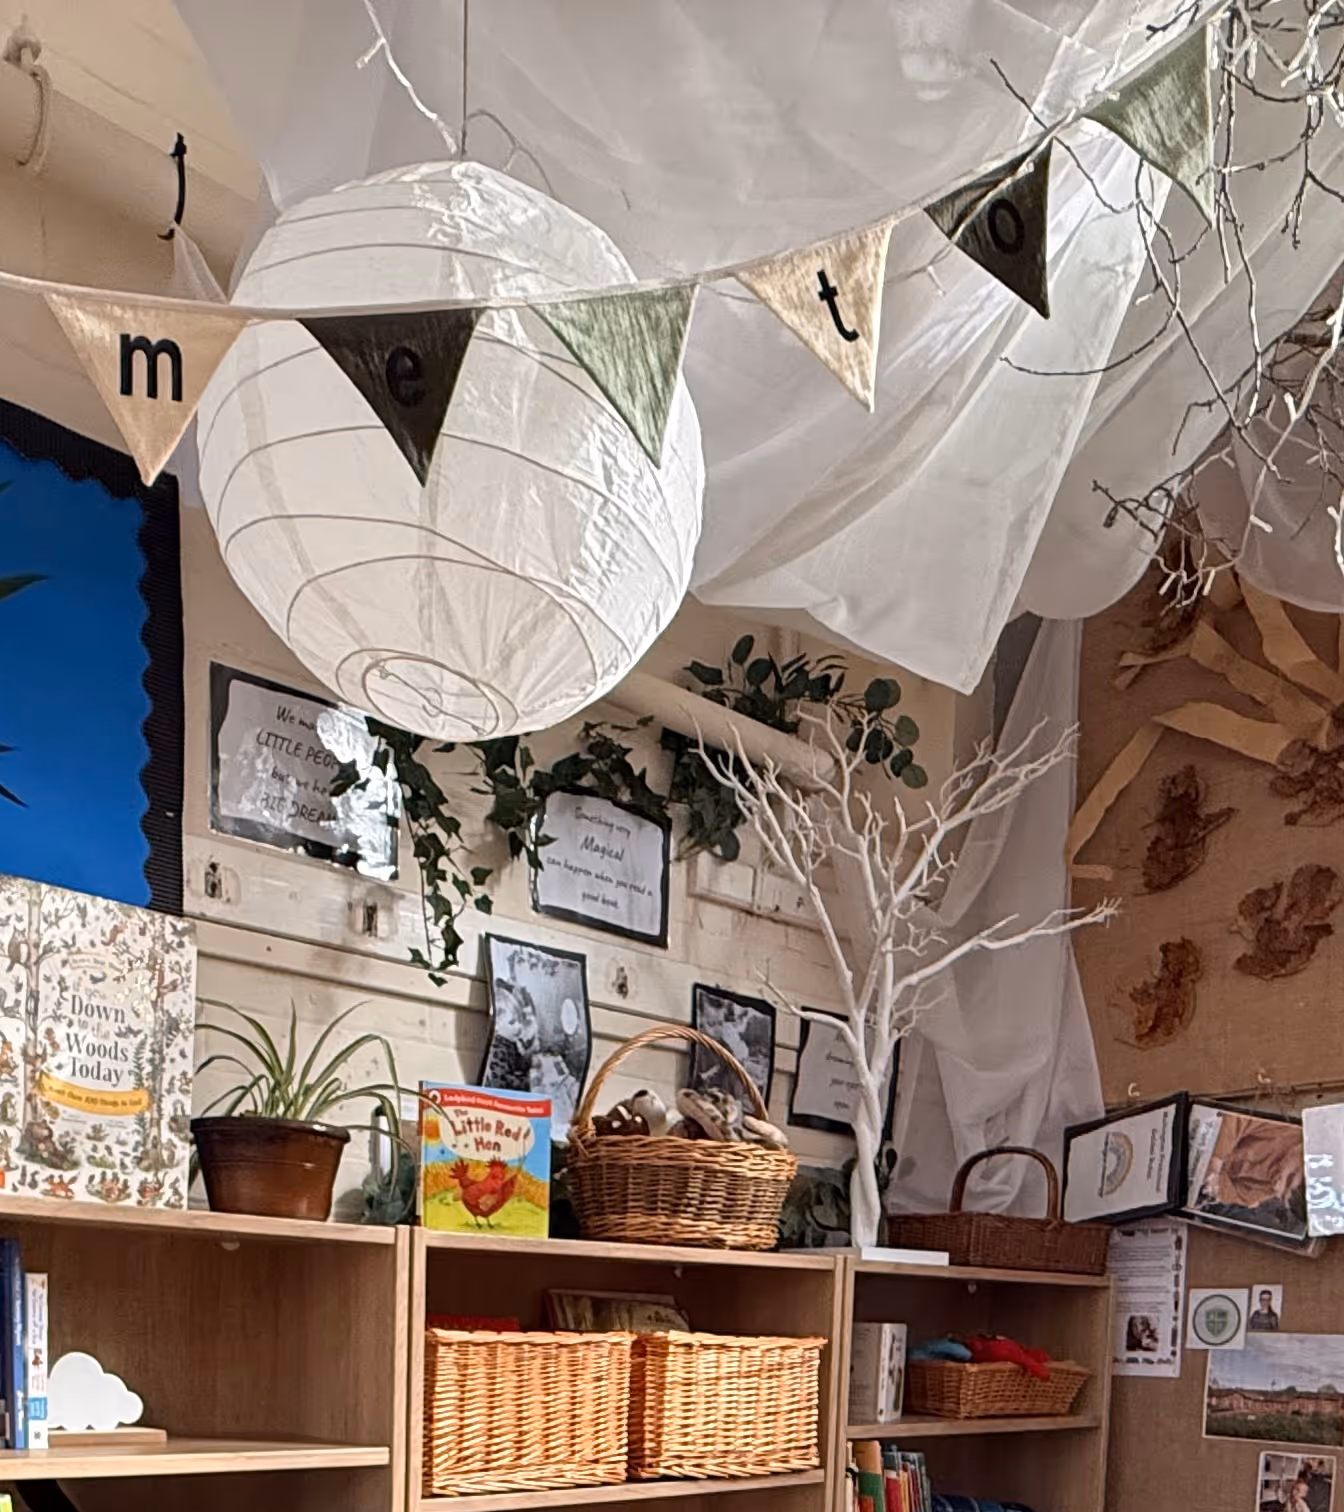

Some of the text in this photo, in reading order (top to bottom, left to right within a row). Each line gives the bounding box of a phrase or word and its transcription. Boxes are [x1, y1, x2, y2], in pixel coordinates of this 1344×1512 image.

[276, 705, 295, 724] We
[257, 730, 303, 760] LITTLE
[580, 835, 625, 862] Magical
[563, 859, 593, 877] happen
[71, 994, 125, 1024] Down
[65, 1032, 129, 1062] Woods
[68, 1056, 125, 1087] Today
[452, 1117, 523, 1141] Little Red
[474, 1137, 502, 1152] Hen
